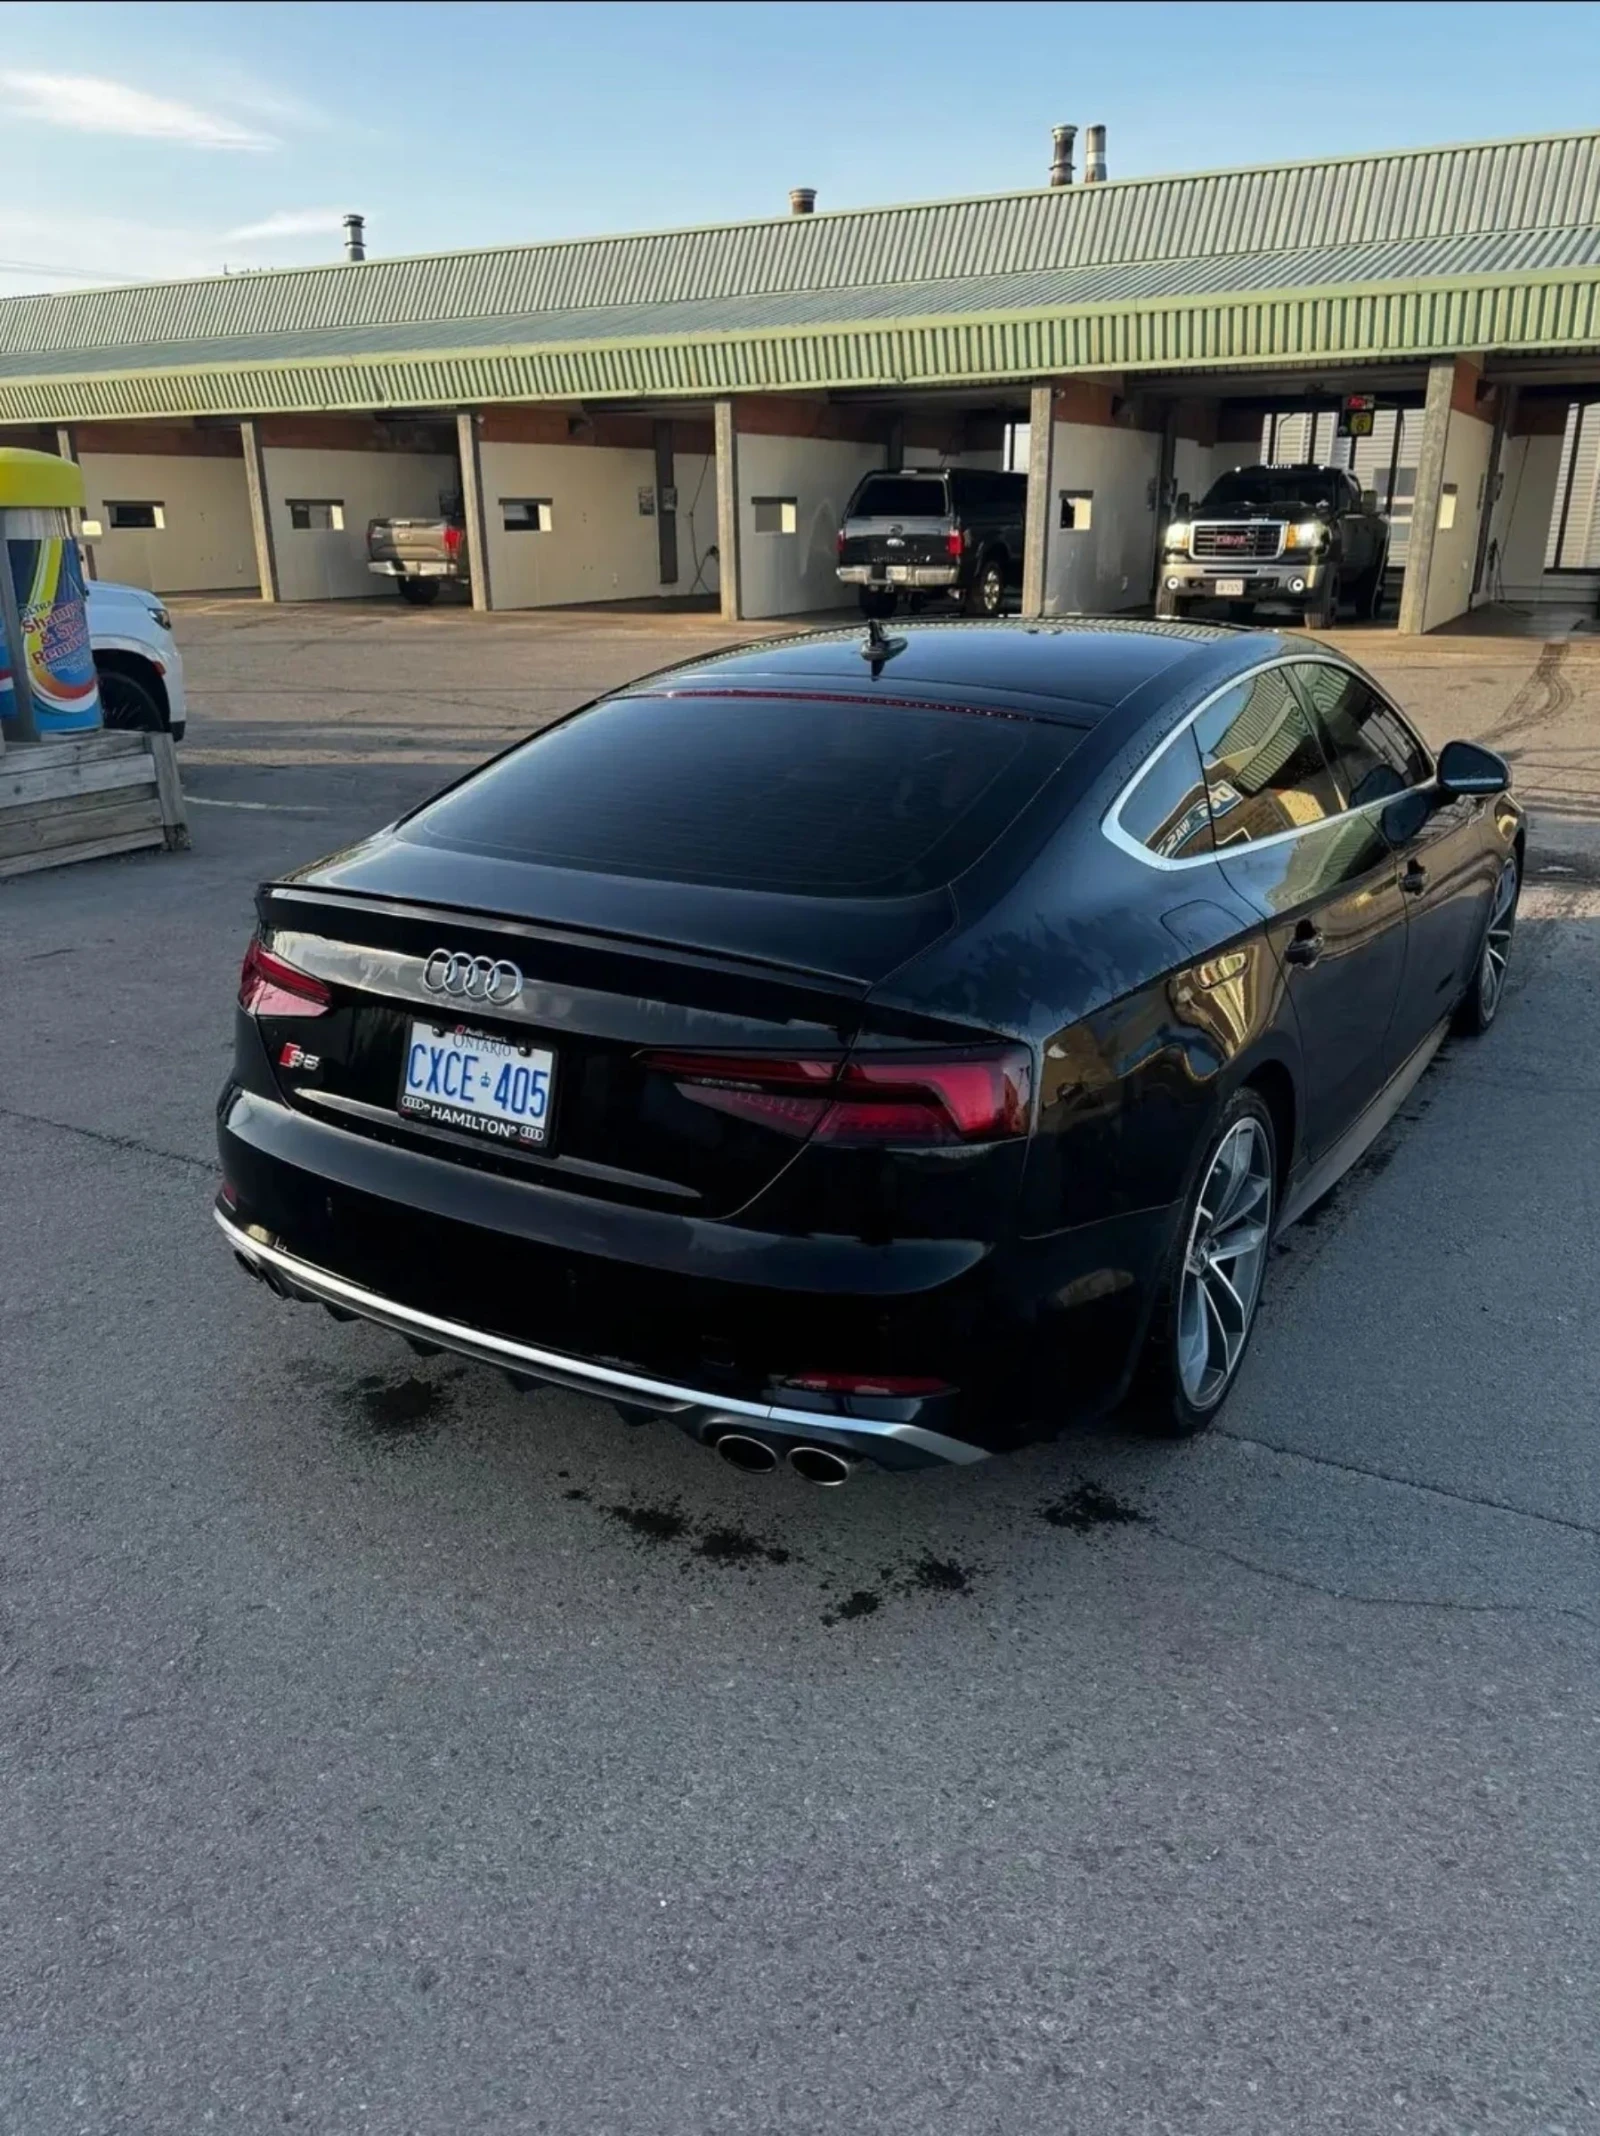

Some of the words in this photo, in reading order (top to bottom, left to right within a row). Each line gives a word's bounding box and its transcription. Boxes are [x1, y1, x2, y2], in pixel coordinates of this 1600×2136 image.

[40, 631, 54, 646] &
[452, 1033, 511, 1057] ONTARIO
[408, 1043, 479, 1103] CXCE
[494, 1062, 548, 1118] 405
[431, 1105, 510, 1137] HAMILTON
